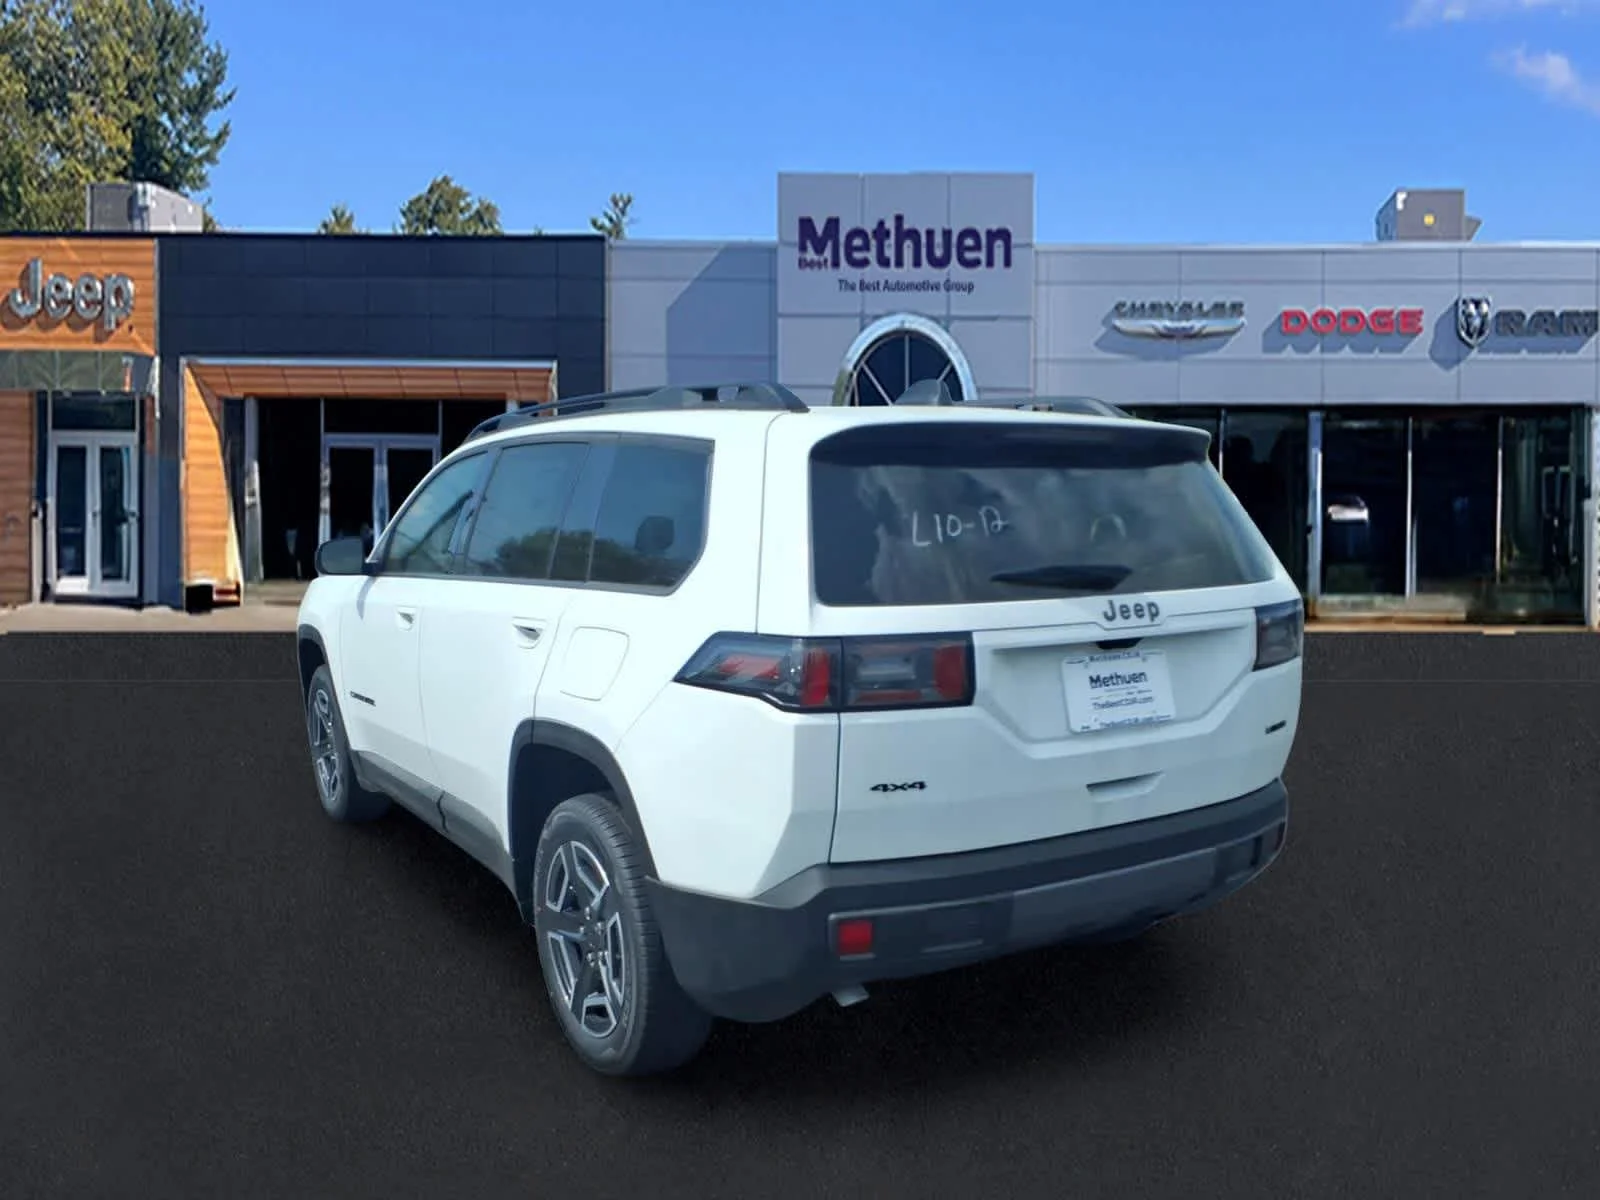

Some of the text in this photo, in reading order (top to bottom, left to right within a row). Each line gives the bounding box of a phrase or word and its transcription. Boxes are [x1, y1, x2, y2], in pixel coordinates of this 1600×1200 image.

[798, 214, 1012, 270] Methuen
[9, 257, 135, 331] Jeep
[838, 278, 975, 295] The Best Automotive Group
[1114, 300, 1245, 318] CHRYSLER
[1281, 308, 1424, 335] DODGE
[1496, 309, 1599, 337] RAM
[1103, 599, 1160, 622] Jeep
[1089, 672, 1148, 689] Methuen
